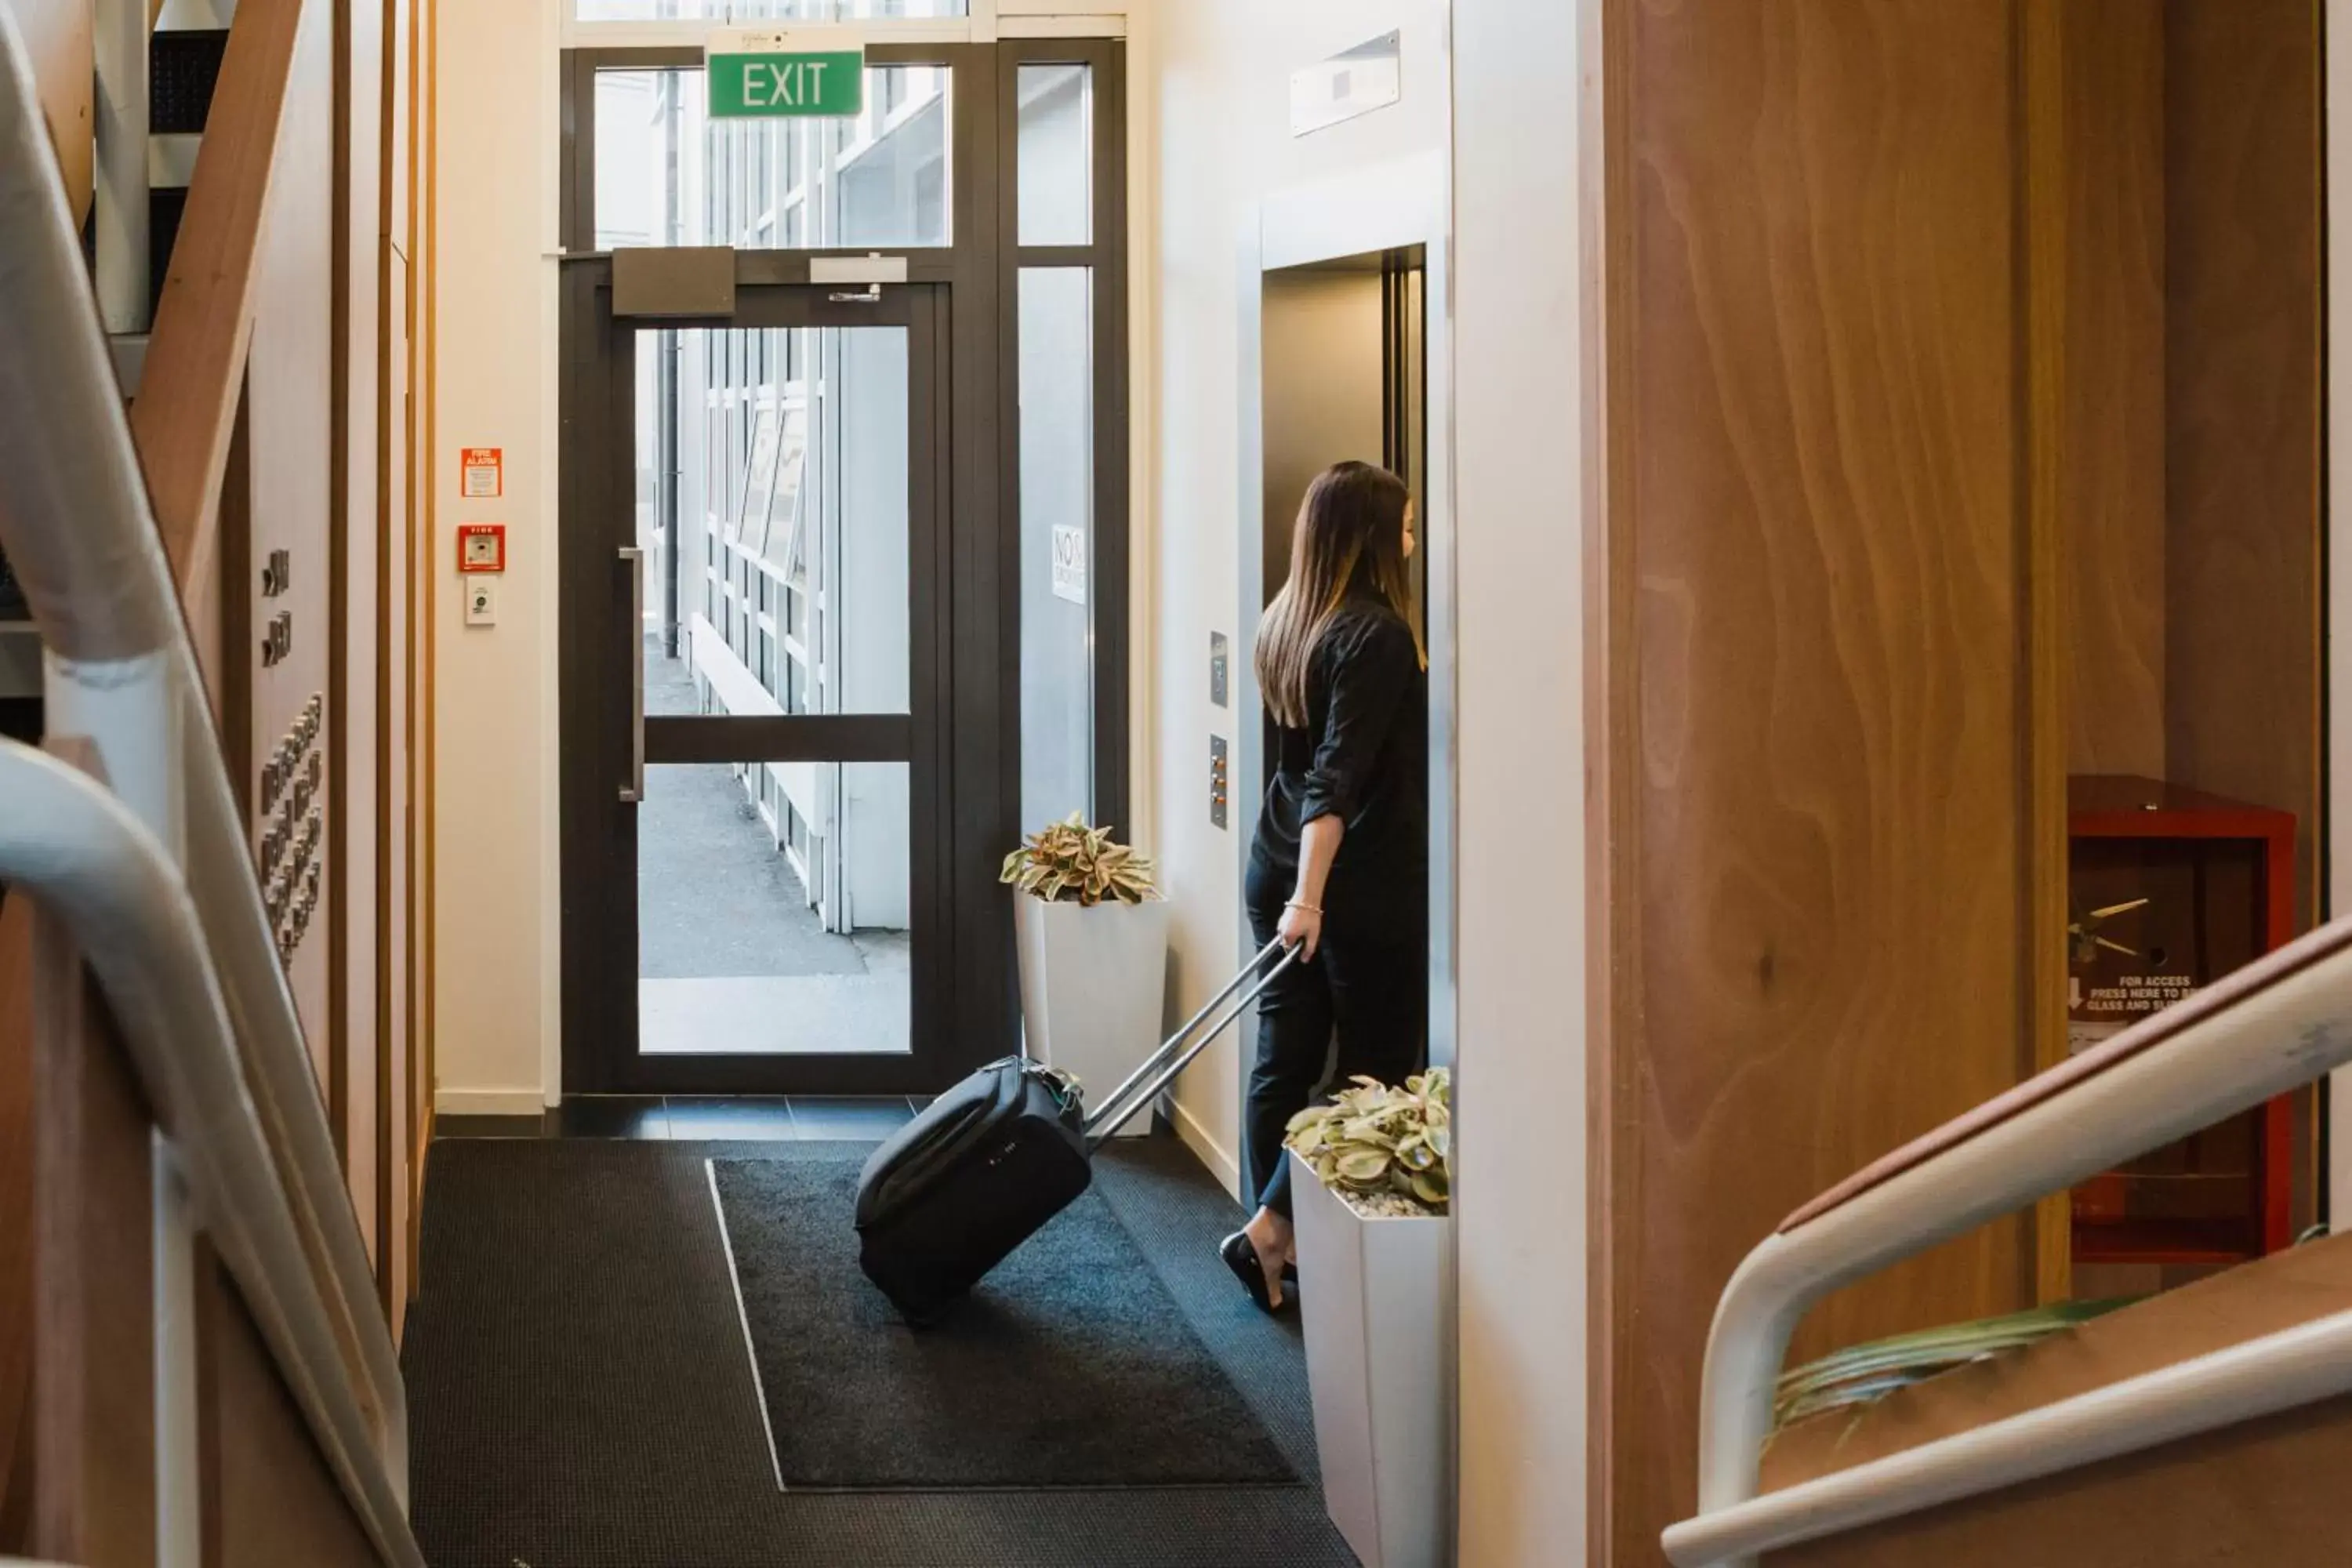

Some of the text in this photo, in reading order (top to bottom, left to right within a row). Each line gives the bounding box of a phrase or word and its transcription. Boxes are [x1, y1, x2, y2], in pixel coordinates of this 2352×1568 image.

[743, 62, 828, 107] EXIT
[2119, 976, 2191, 986] FOR ACCESS
[2089, 989, 2128, 999] PRESS
[2130, 989, 2161, 999] HERE
[2163, 989, 2179, 999] TO
[2086, 1000, 2125, 1011] GLASS
[2126, 1000, 2151, 1011] AND
